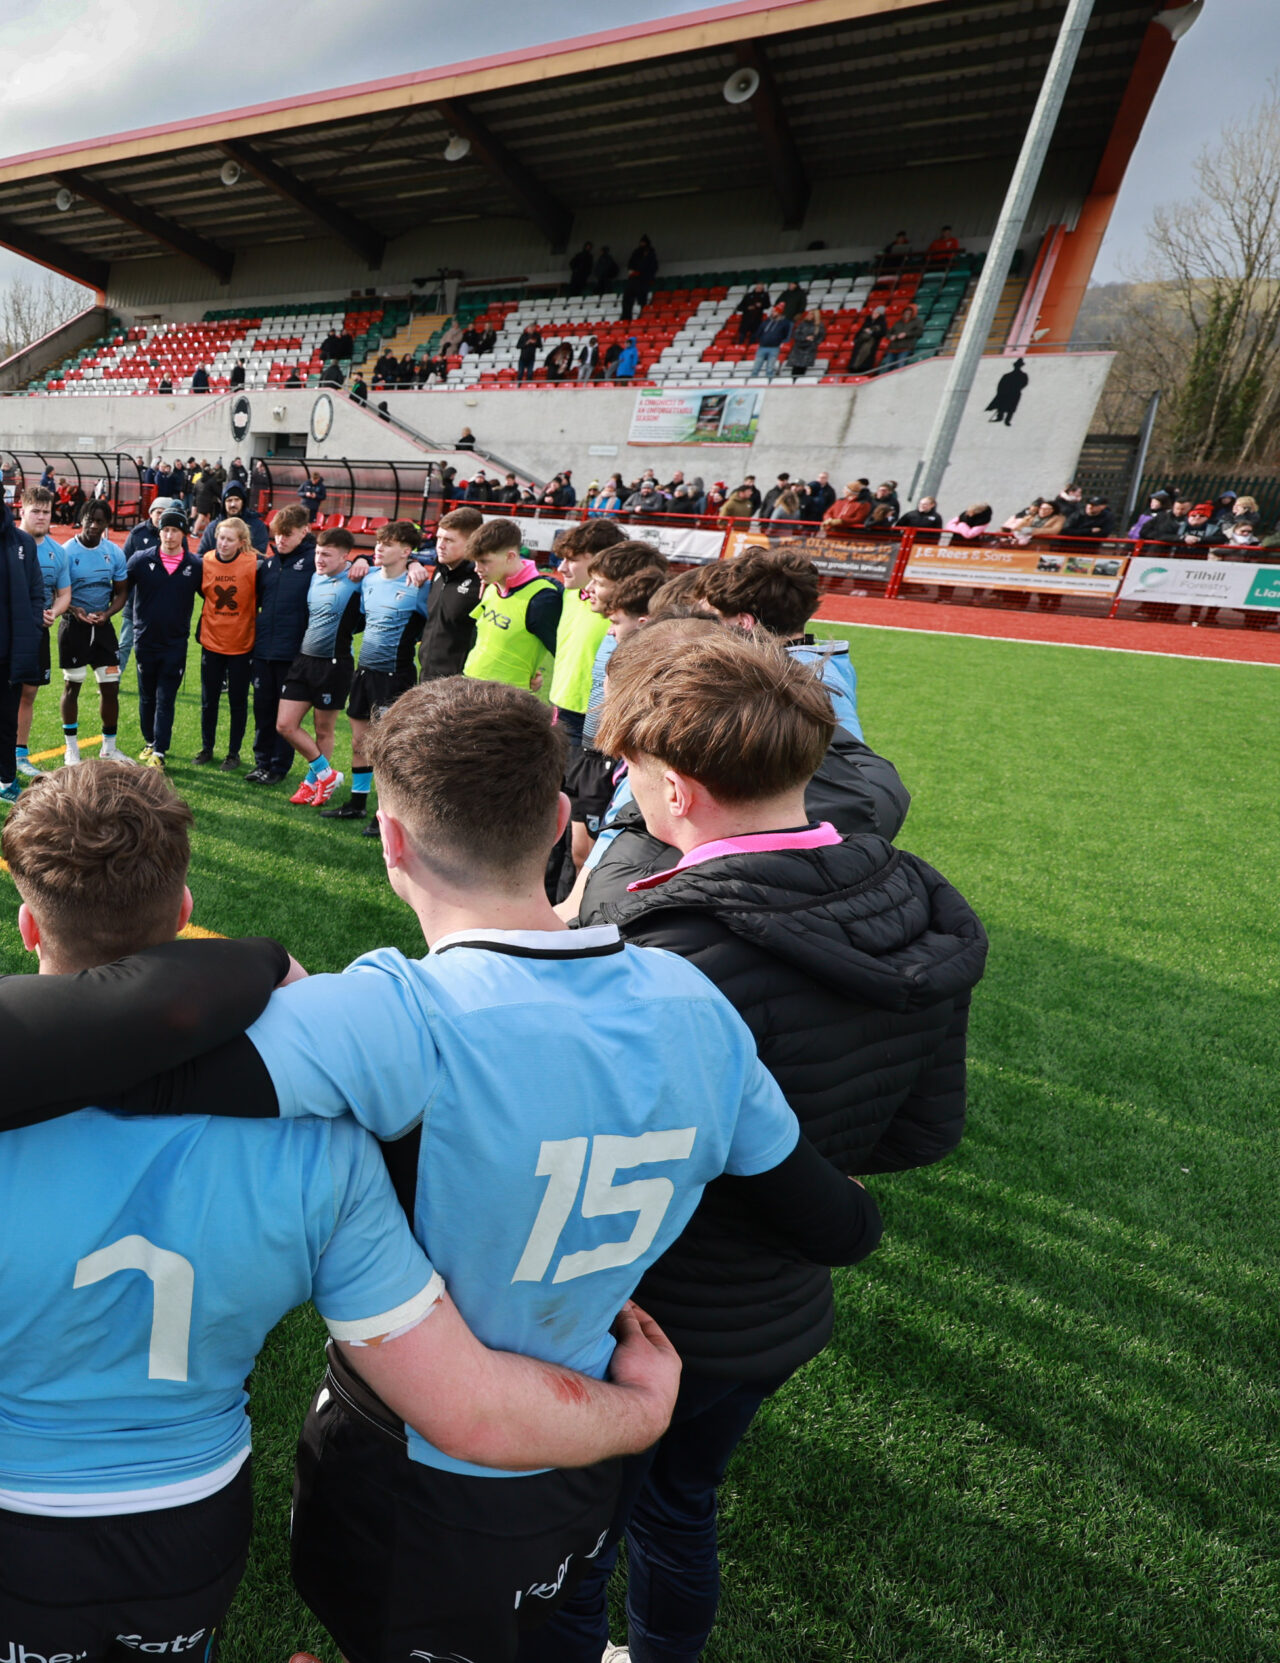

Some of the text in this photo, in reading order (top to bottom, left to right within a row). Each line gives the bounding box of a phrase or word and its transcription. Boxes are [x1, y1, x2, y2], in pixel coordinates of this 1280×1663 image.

[824, 550, 849, 561] dog
[851, 551, 890, 563] treats
[914, 546, 1013, 562] J.E. Rees & Sons
[1185, 570, 1227, 582] Tilhill
[1179, 580, 1232, 592] Forestry
[482, 608, 511, 630] VX3
[511, 1126, 697, 1286] 15
[72, 1234, 195, 1382] 7
